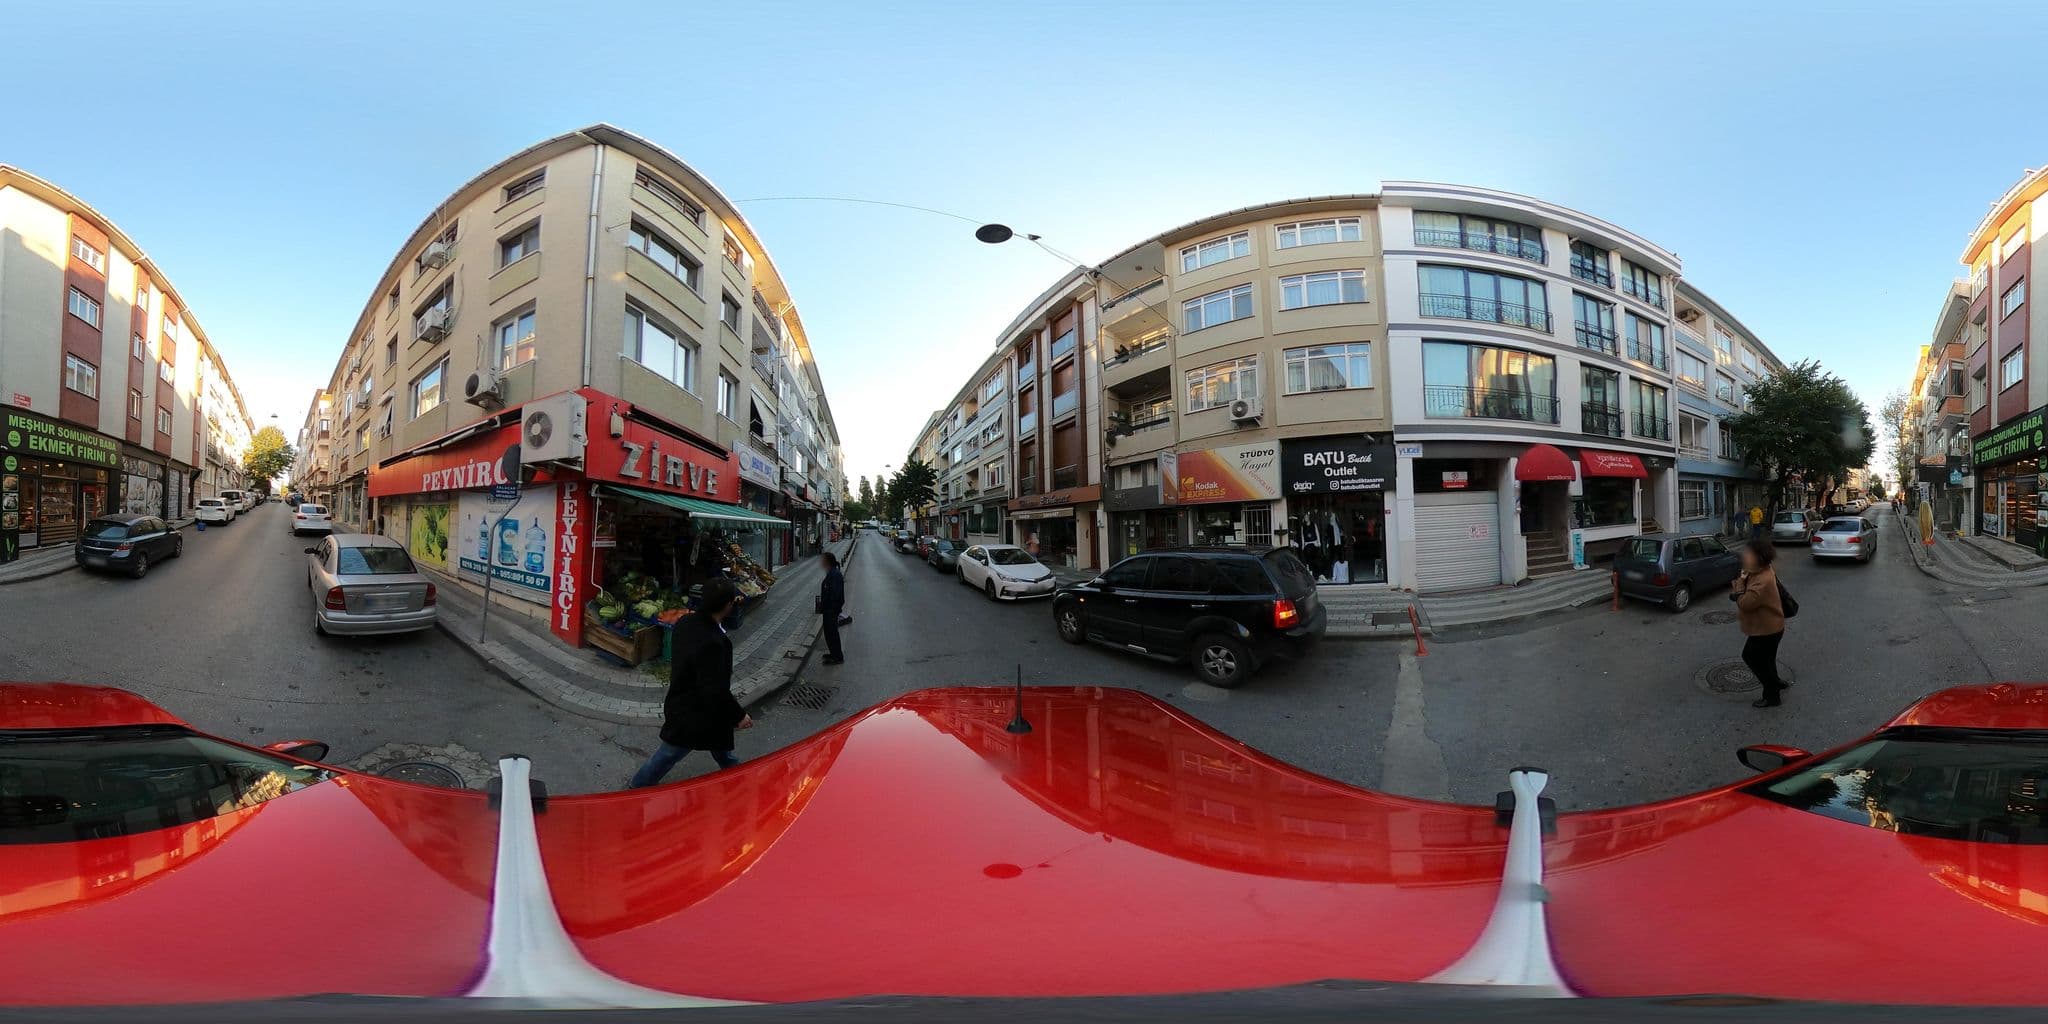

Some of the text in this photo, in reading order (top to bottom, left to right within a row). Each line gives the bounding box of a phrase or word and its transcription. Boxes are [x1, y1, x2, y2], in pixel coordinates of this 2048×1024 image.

[8, 414, 117, 451] MEŞHUR SOMUNCU BABA
[2022, 414, 2043, 432] BABA
[29, 434, 75, 457] EKMEK
[77, 445, 106, 463] FIRINI
[1303, 450, 1372, 466] BATU Butik
[1981, 435, 2029, 462] EKMEK FIRINI
[421, 457, 509, 492] PEYNİRC
[619, 440, 718, 494] ZİRVE
[1324, 466, 1357, 477] Outlet
[1187, 488, 1226, 498] EXPRESS
[1195, 481, 1218, 490] Kodak
[558, 482, 578, 631] PEYNİRCİ
[535, 577, 546, 587] 67
